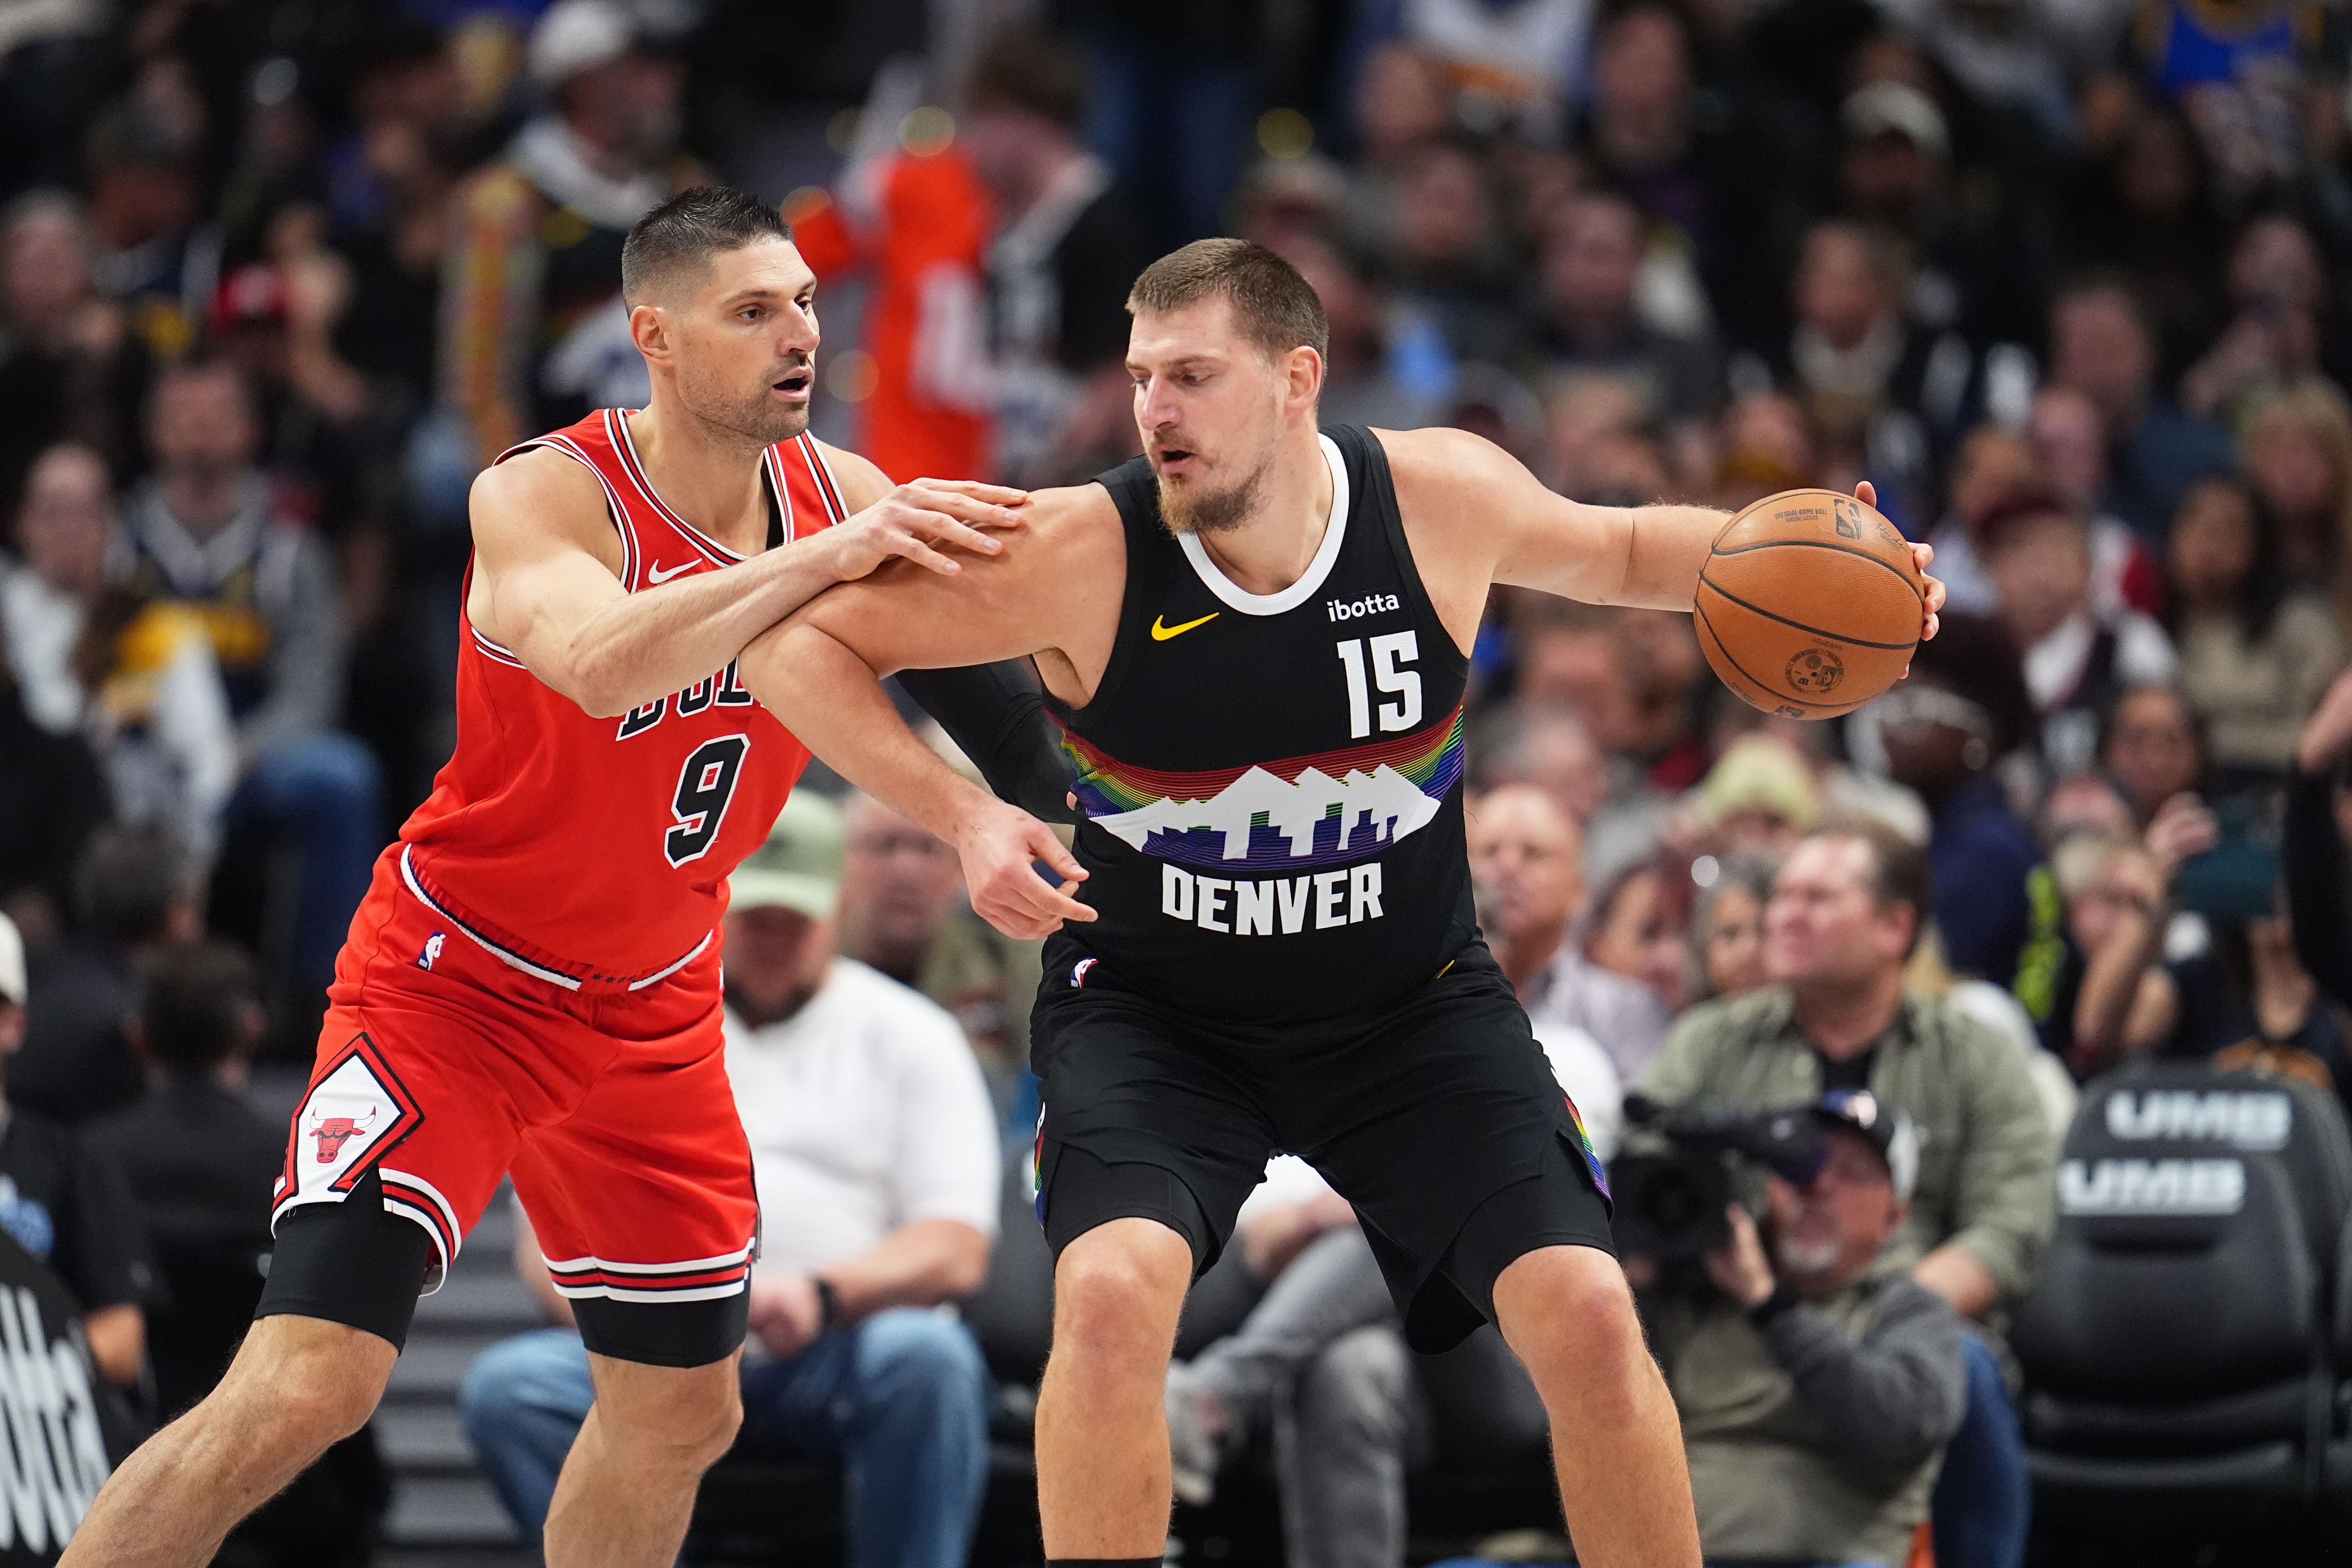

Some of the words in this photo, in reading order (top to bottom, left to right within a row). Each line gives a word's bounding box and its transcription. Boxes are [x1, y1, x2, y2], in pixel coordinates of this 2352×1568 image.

[1327, 593, 1400, 622] ibotta
[1337, 630, 1422, 739] 15
[664, 733, 751, 869] 9
[1162, 862, 1384, 936] DENVER
[418, 958, 428, 968] NBA
